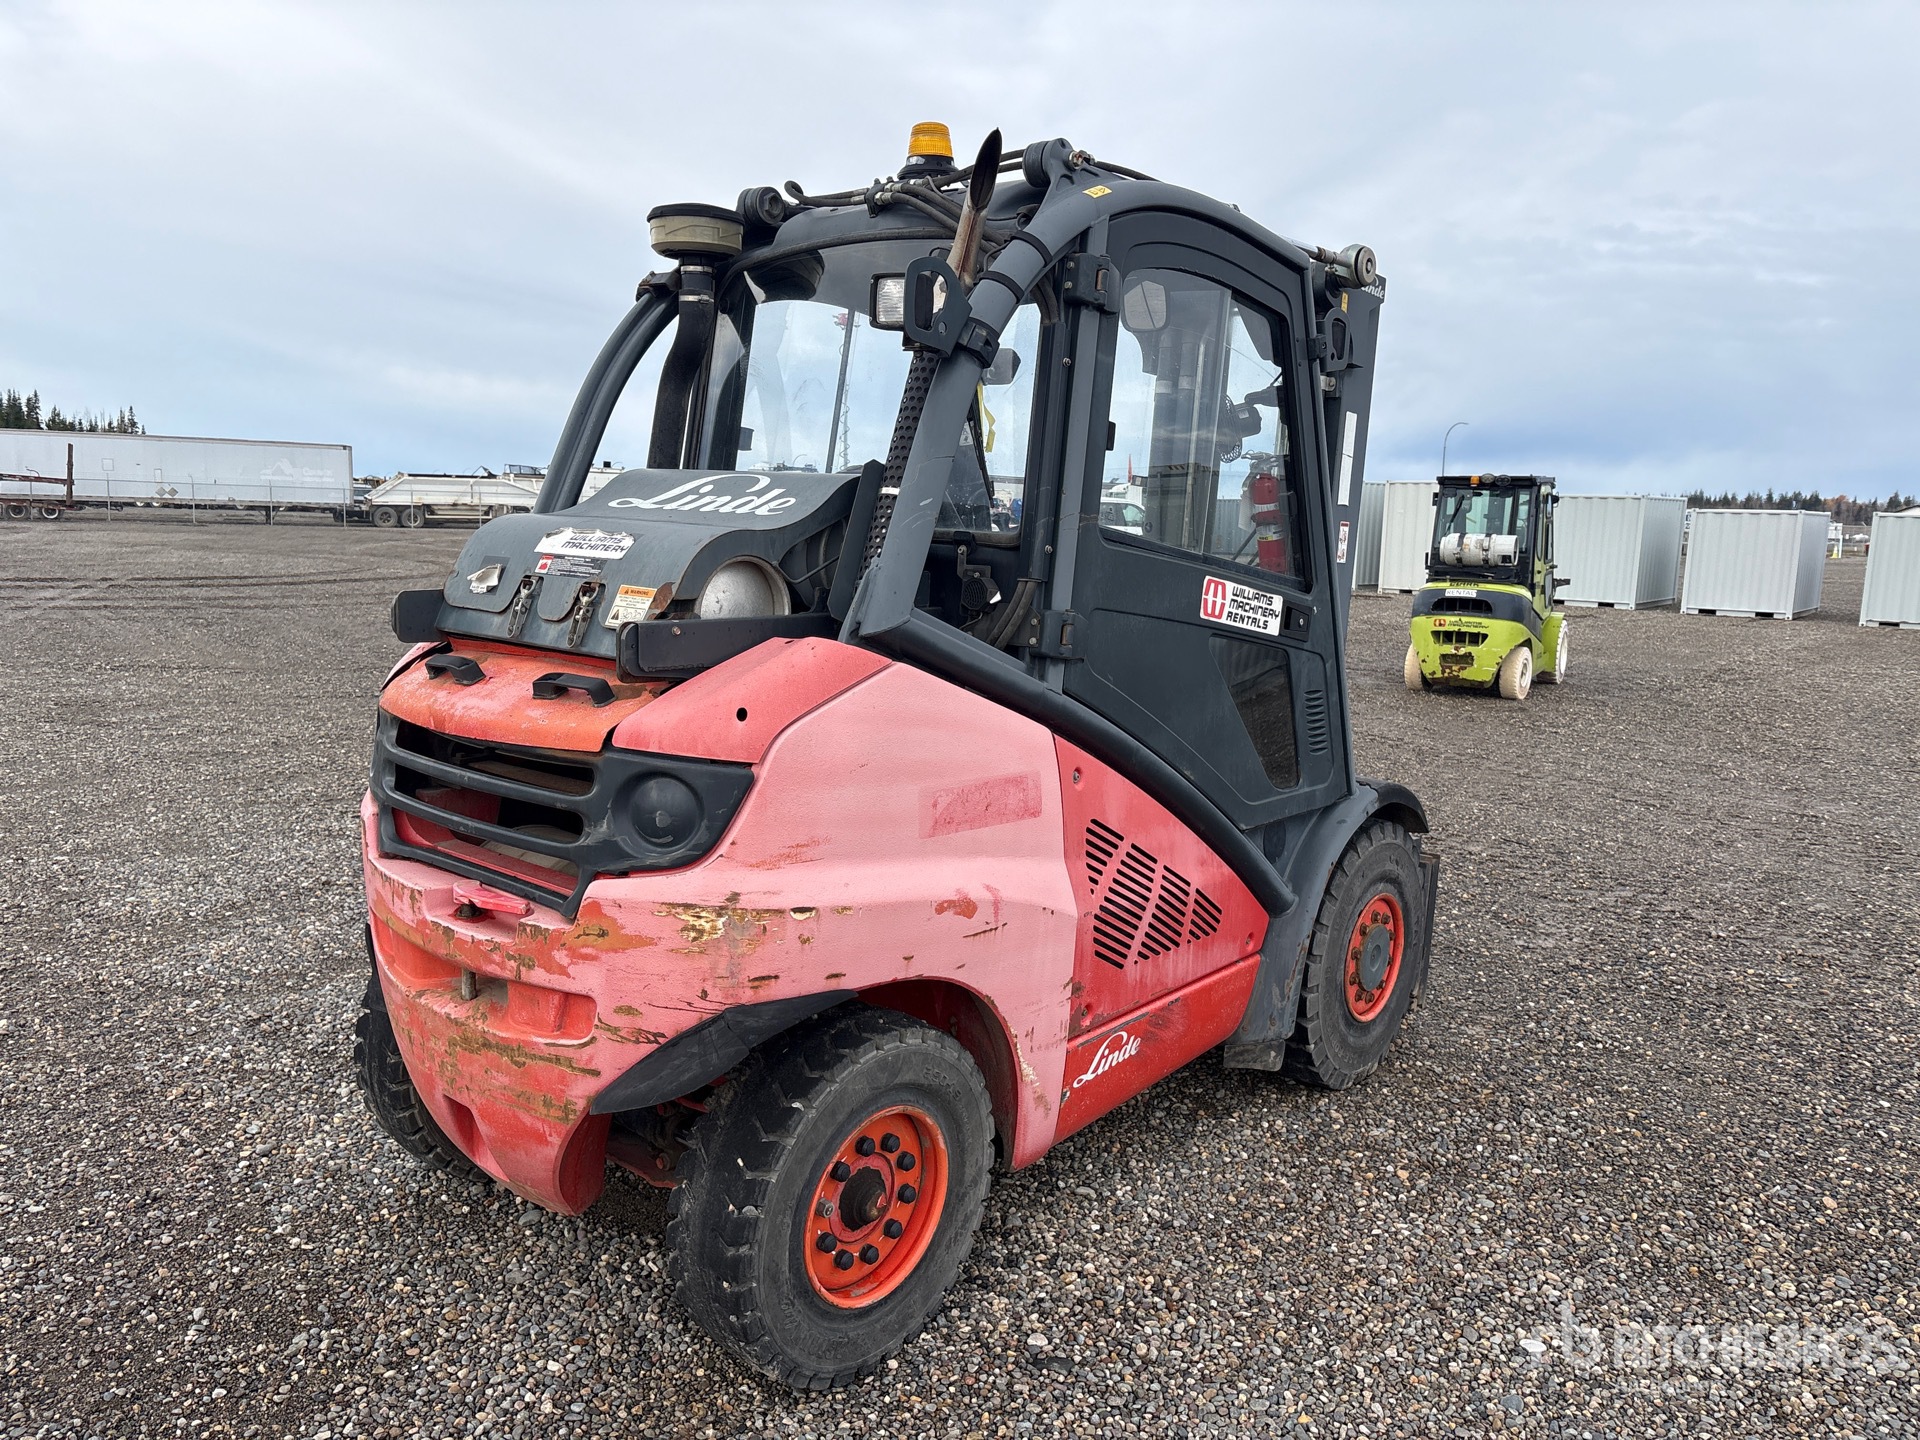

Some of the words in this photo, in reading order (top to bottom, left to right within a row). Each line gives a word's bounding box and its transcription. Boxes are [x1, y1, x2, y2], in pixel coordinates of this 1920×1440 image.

[1361, 276, 1385, 299] inde
[608, 474, 797, 516] Linde
[561, 541, 630, 553] MACHINERY
[570, 534, 626, 544] WILLIAMS
[1231, 585, 1274, 607] WILLIAMS
[1226, 611, 1269, 630] RENTALS
[1228, 598, 1281, 621] MACHINERY
[1072, 1031, 1141, 1088] Linde
